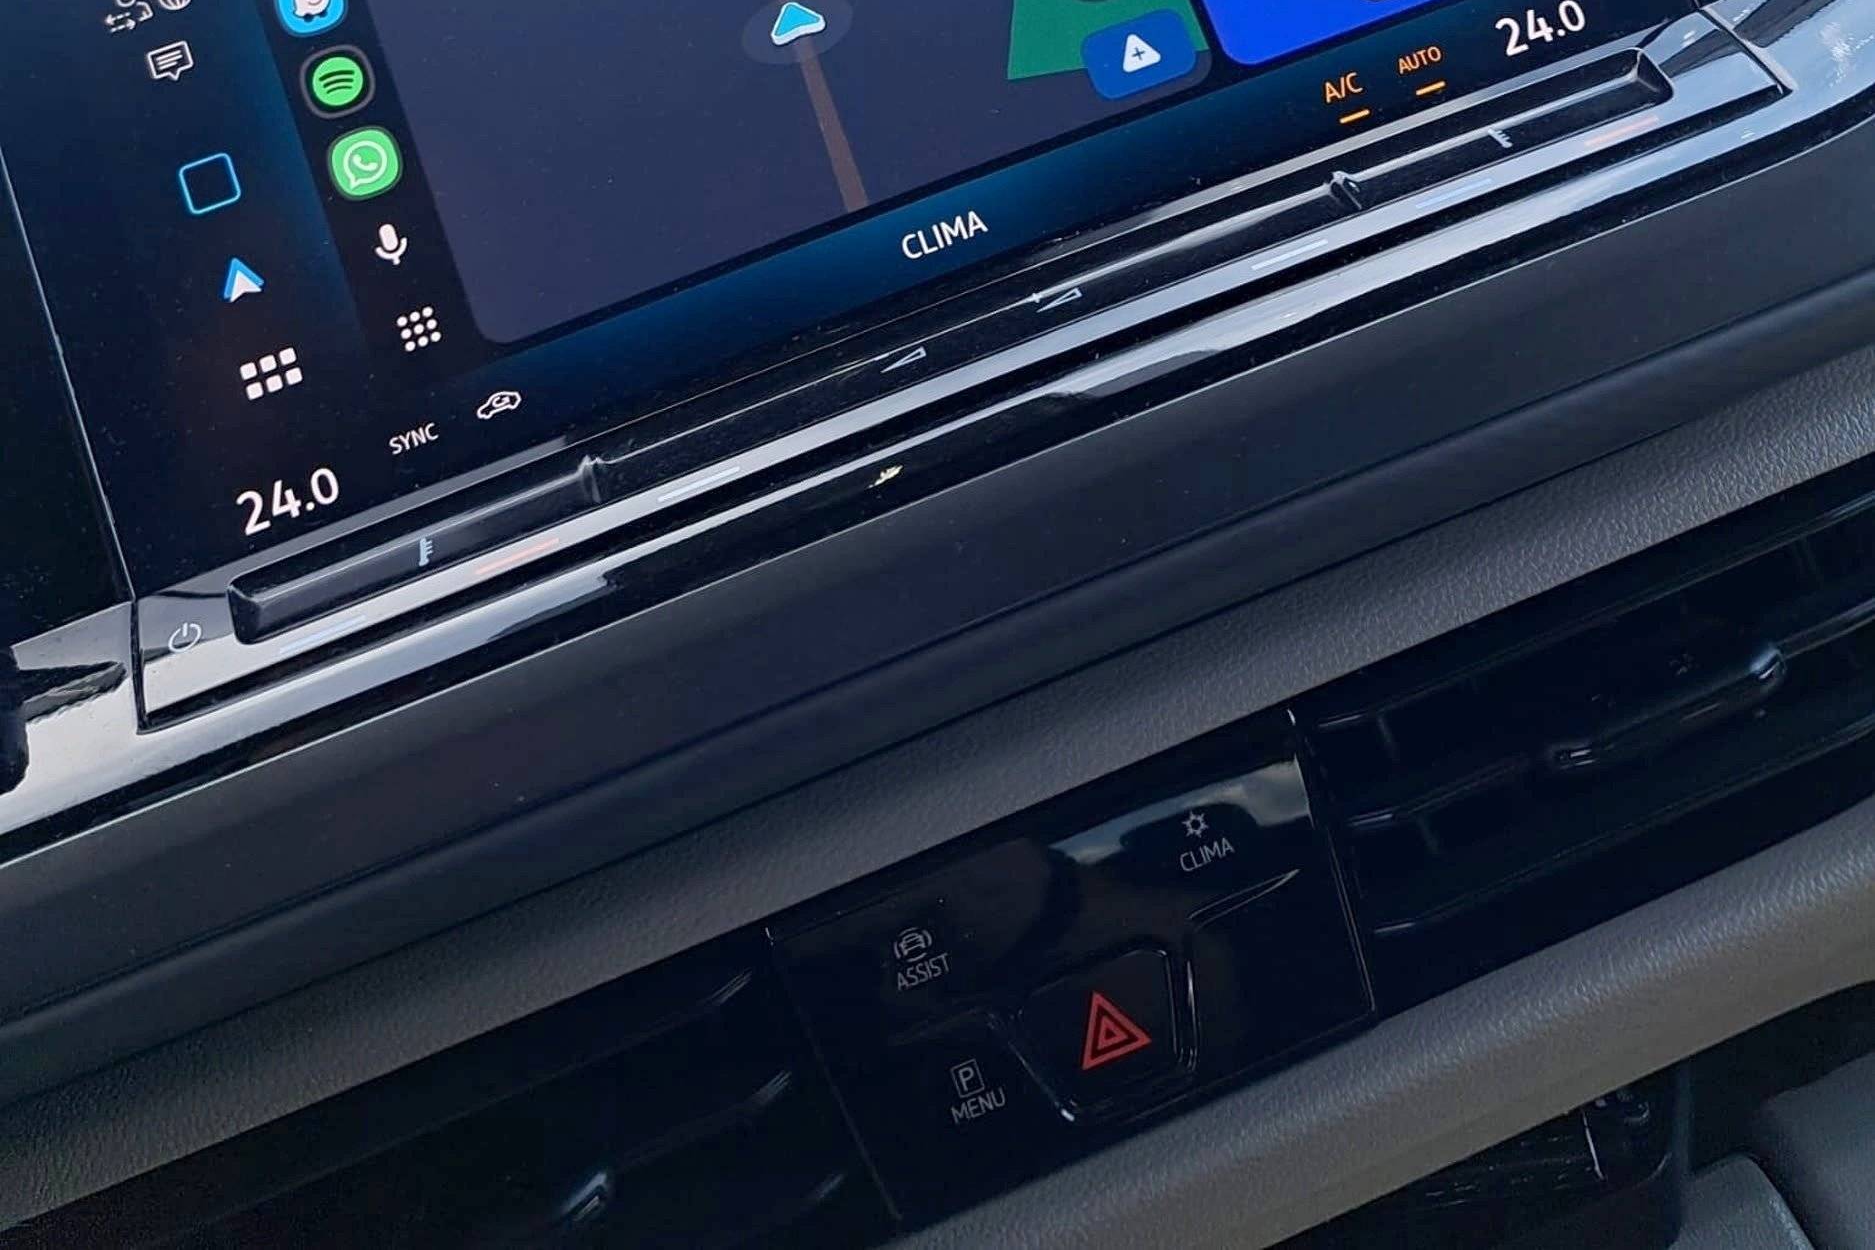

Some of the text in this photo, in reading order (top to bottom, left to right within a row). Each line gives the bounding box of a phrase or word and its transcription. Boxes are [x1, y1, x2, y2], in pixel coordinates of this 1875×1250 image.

[1495, 0, 1587, 58] 24.0
[1398, 46, 1442, 75] AUTO
[1324, 72, 1364, 103] A/C
[901, 210, 989, 260] CLIMA
[389, 422, 439, 455] SYNC
[236, 468, 340, 536] 24.0
[1179, 837, 1235, 872] CLIMA
[895, 953, 951, 991] ASSIST
[951, 1087, 1006, 1125] MENU
